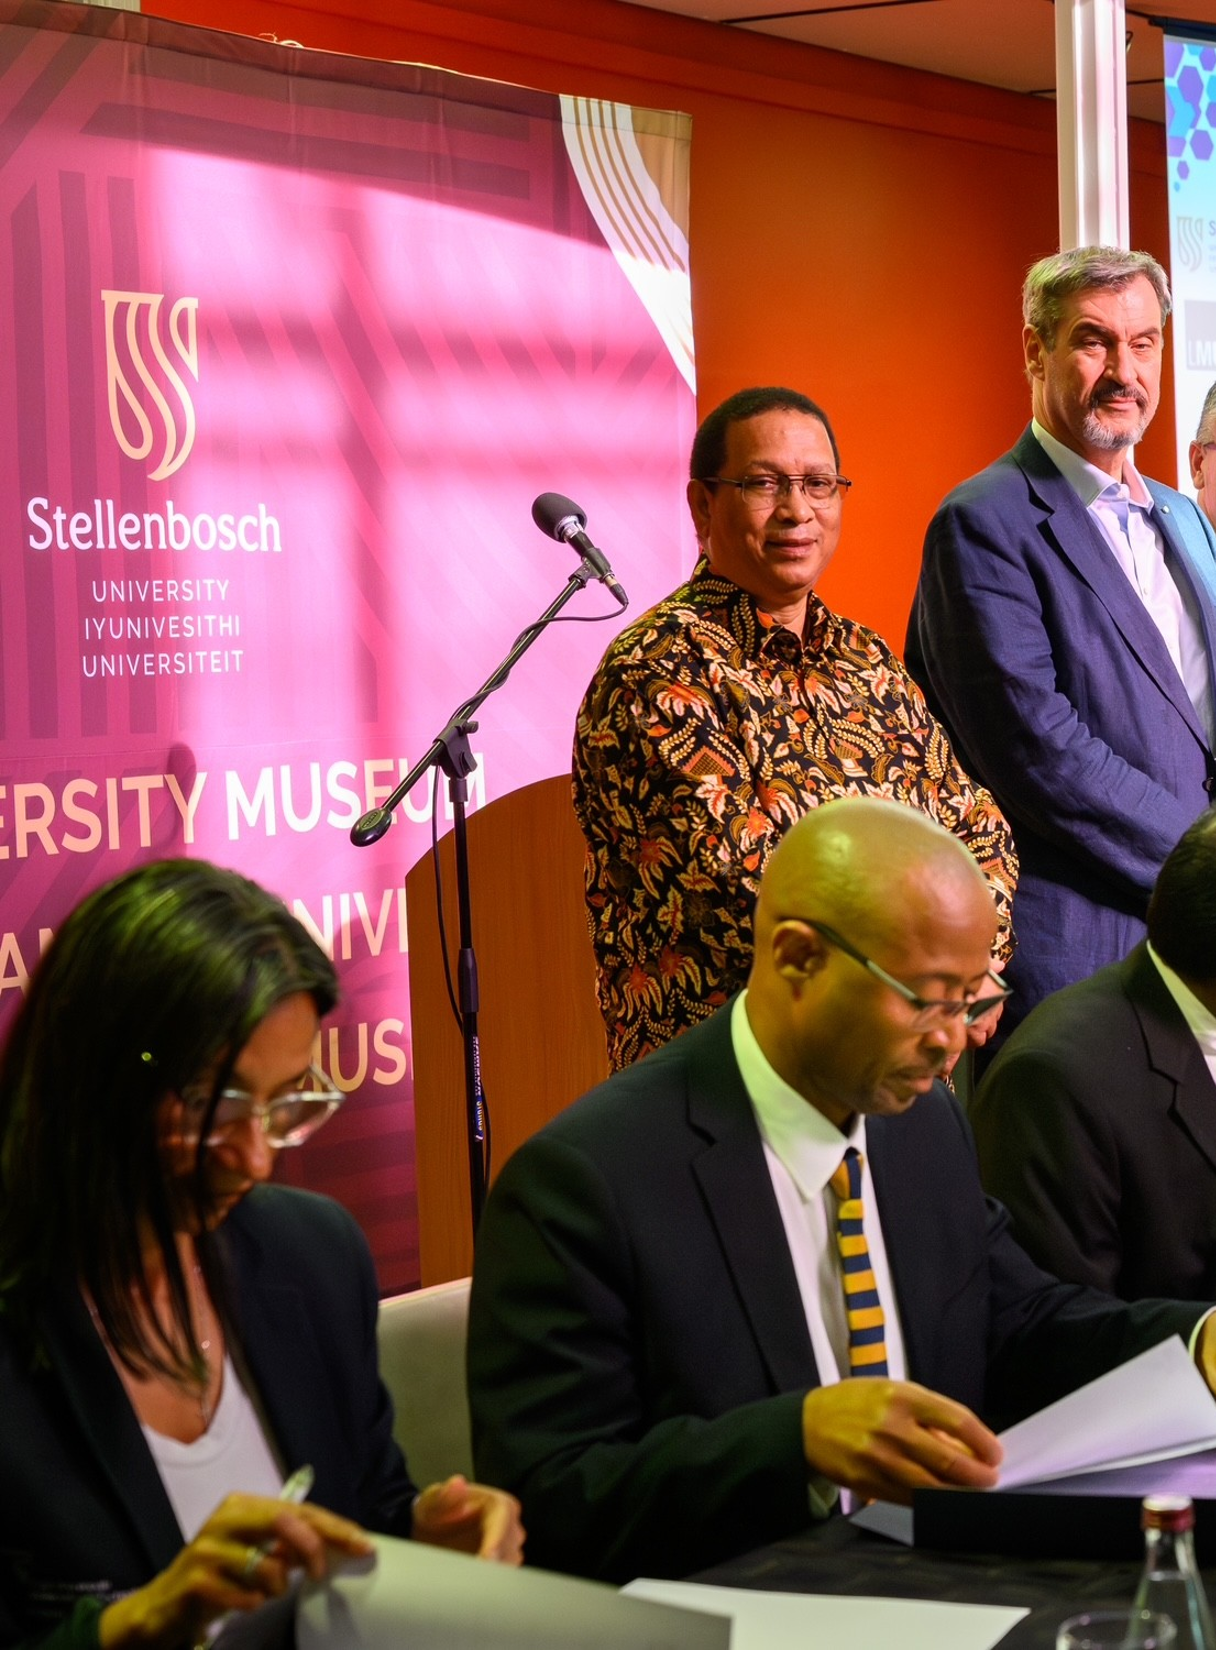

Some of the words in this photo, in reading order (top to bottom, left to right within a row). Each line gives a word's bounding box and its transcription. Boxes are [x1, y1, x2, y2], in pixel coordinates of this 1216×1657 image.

[26, 496, 282, 553] Stellenbosch
[92, 579, 230, 603] UNIVERSITY
[85, 614, 241, 641] IYUNIVESITHI
[82, 649, 244, 677] UNIVERSITEIT
